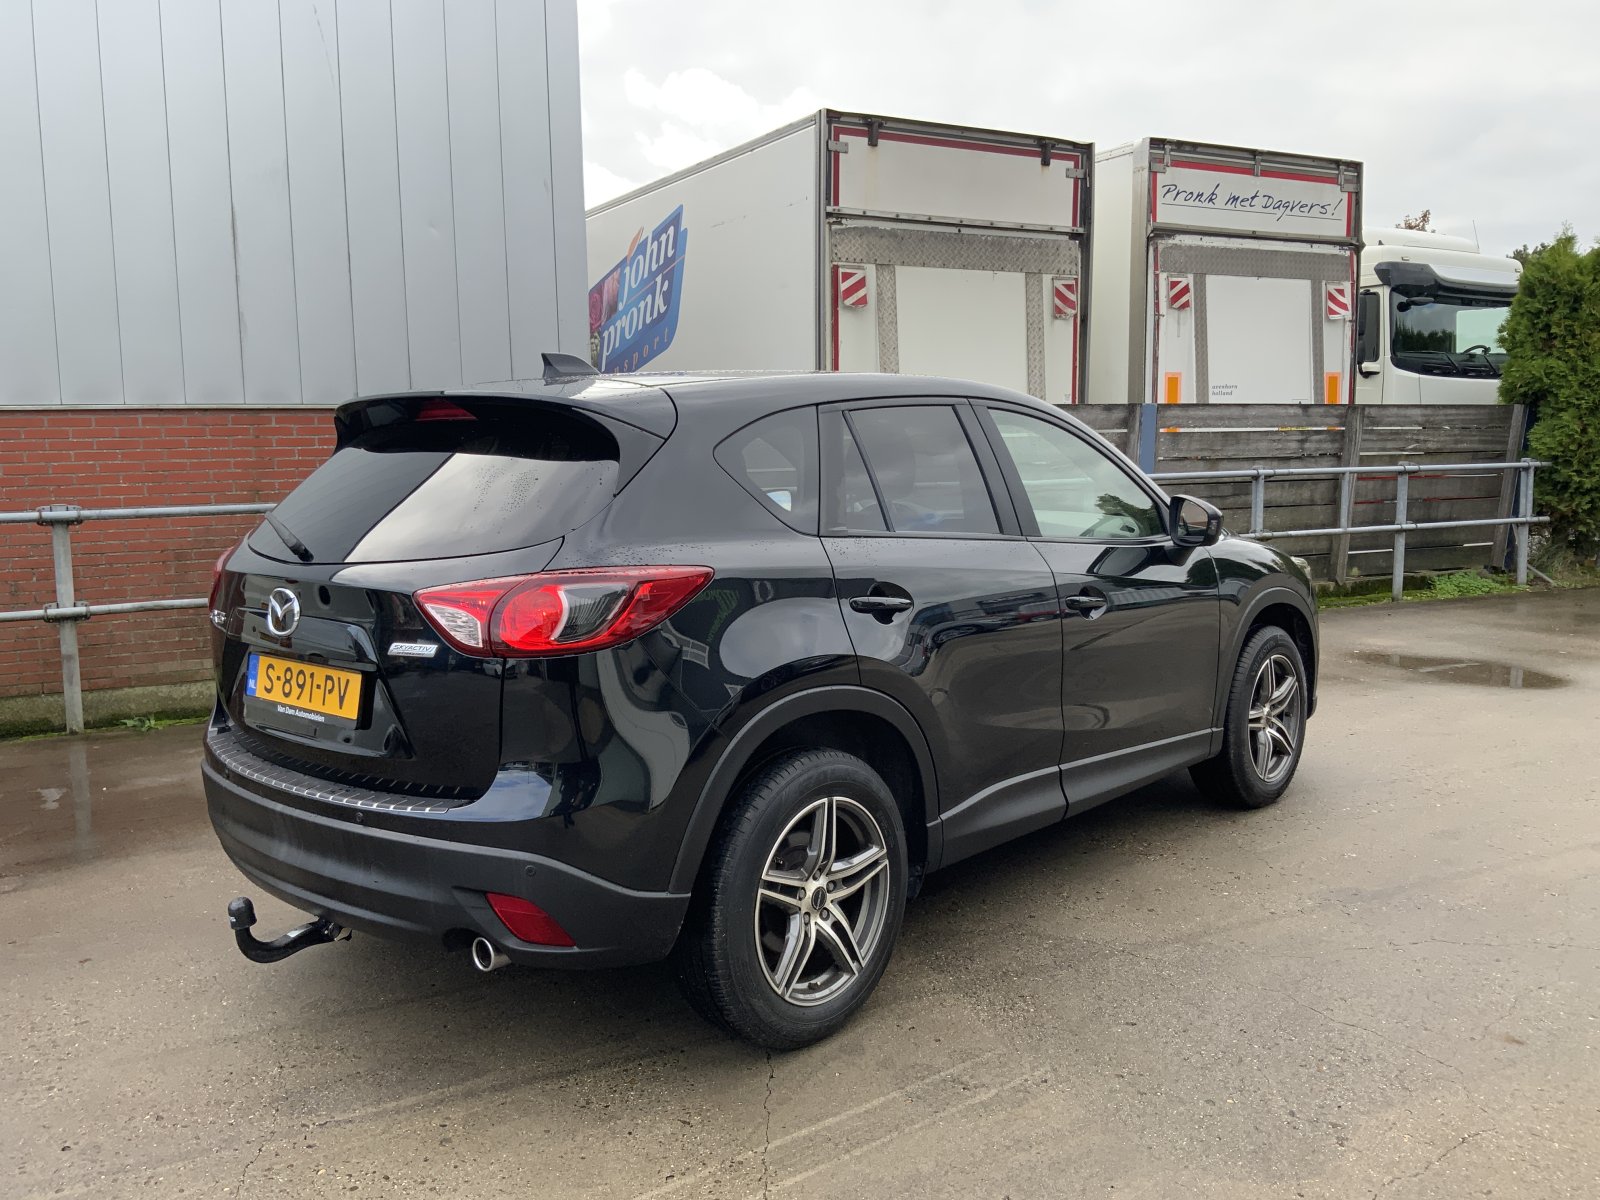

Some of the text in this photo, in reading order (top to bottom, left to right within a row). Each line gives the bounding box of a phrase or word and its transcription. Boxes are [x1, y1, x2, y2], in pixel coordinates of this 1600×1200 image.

[1161, 183, 1220, 206] Pronk
[1225, 190, 1260, 209] met
[618, 224, 675, 311] john
[601, 273, 669, 373] pronk
[393, 644, 433, 652] SKYACTIV
[263, 663, 350, 710] S-891-PV
